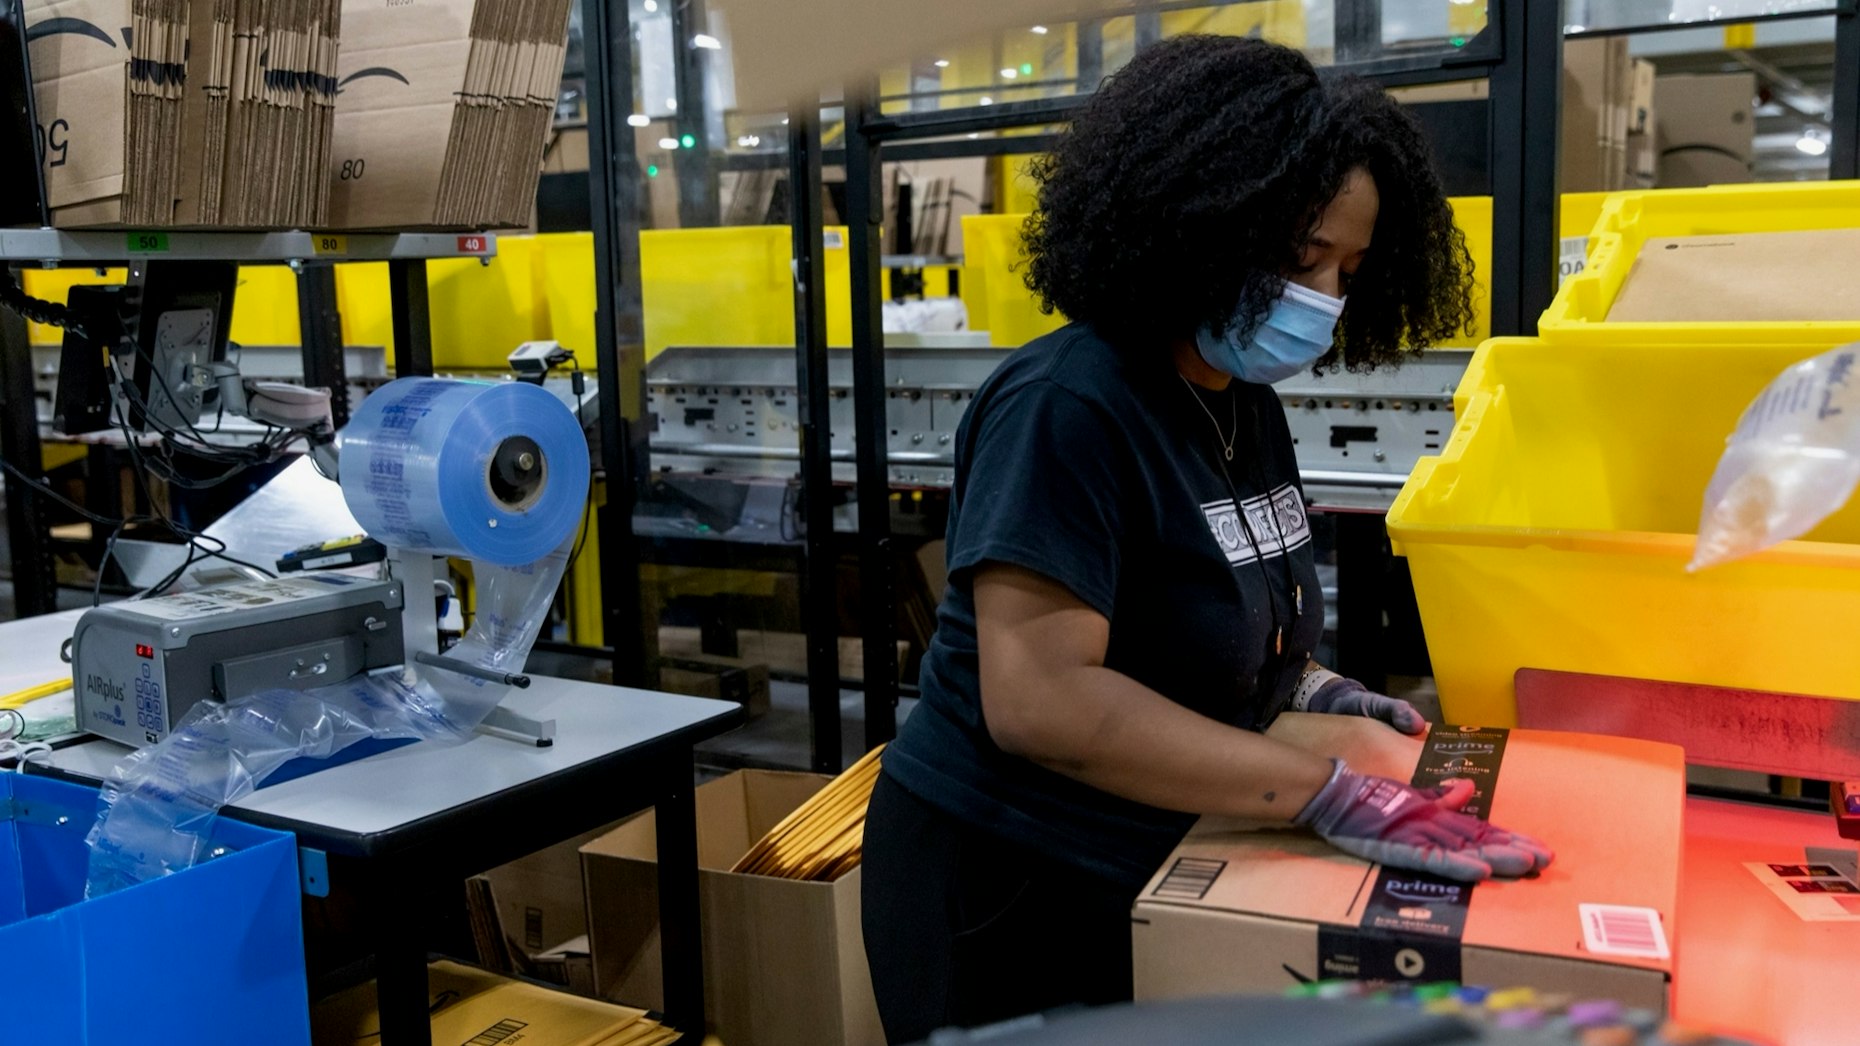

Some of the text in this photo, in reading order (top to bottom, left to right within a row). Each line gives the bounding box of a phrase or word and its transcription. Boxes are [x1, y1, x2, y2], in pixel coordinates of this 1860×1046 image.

[340, 158, 365, 180] 80
[139, 235, 158, 249] 50
[322, 238, 337, 250] 80
[465, 238, 479, 250] 40
[1433, 741, 1495, 751] prime
[1385, 879, 1461, 895] prime
